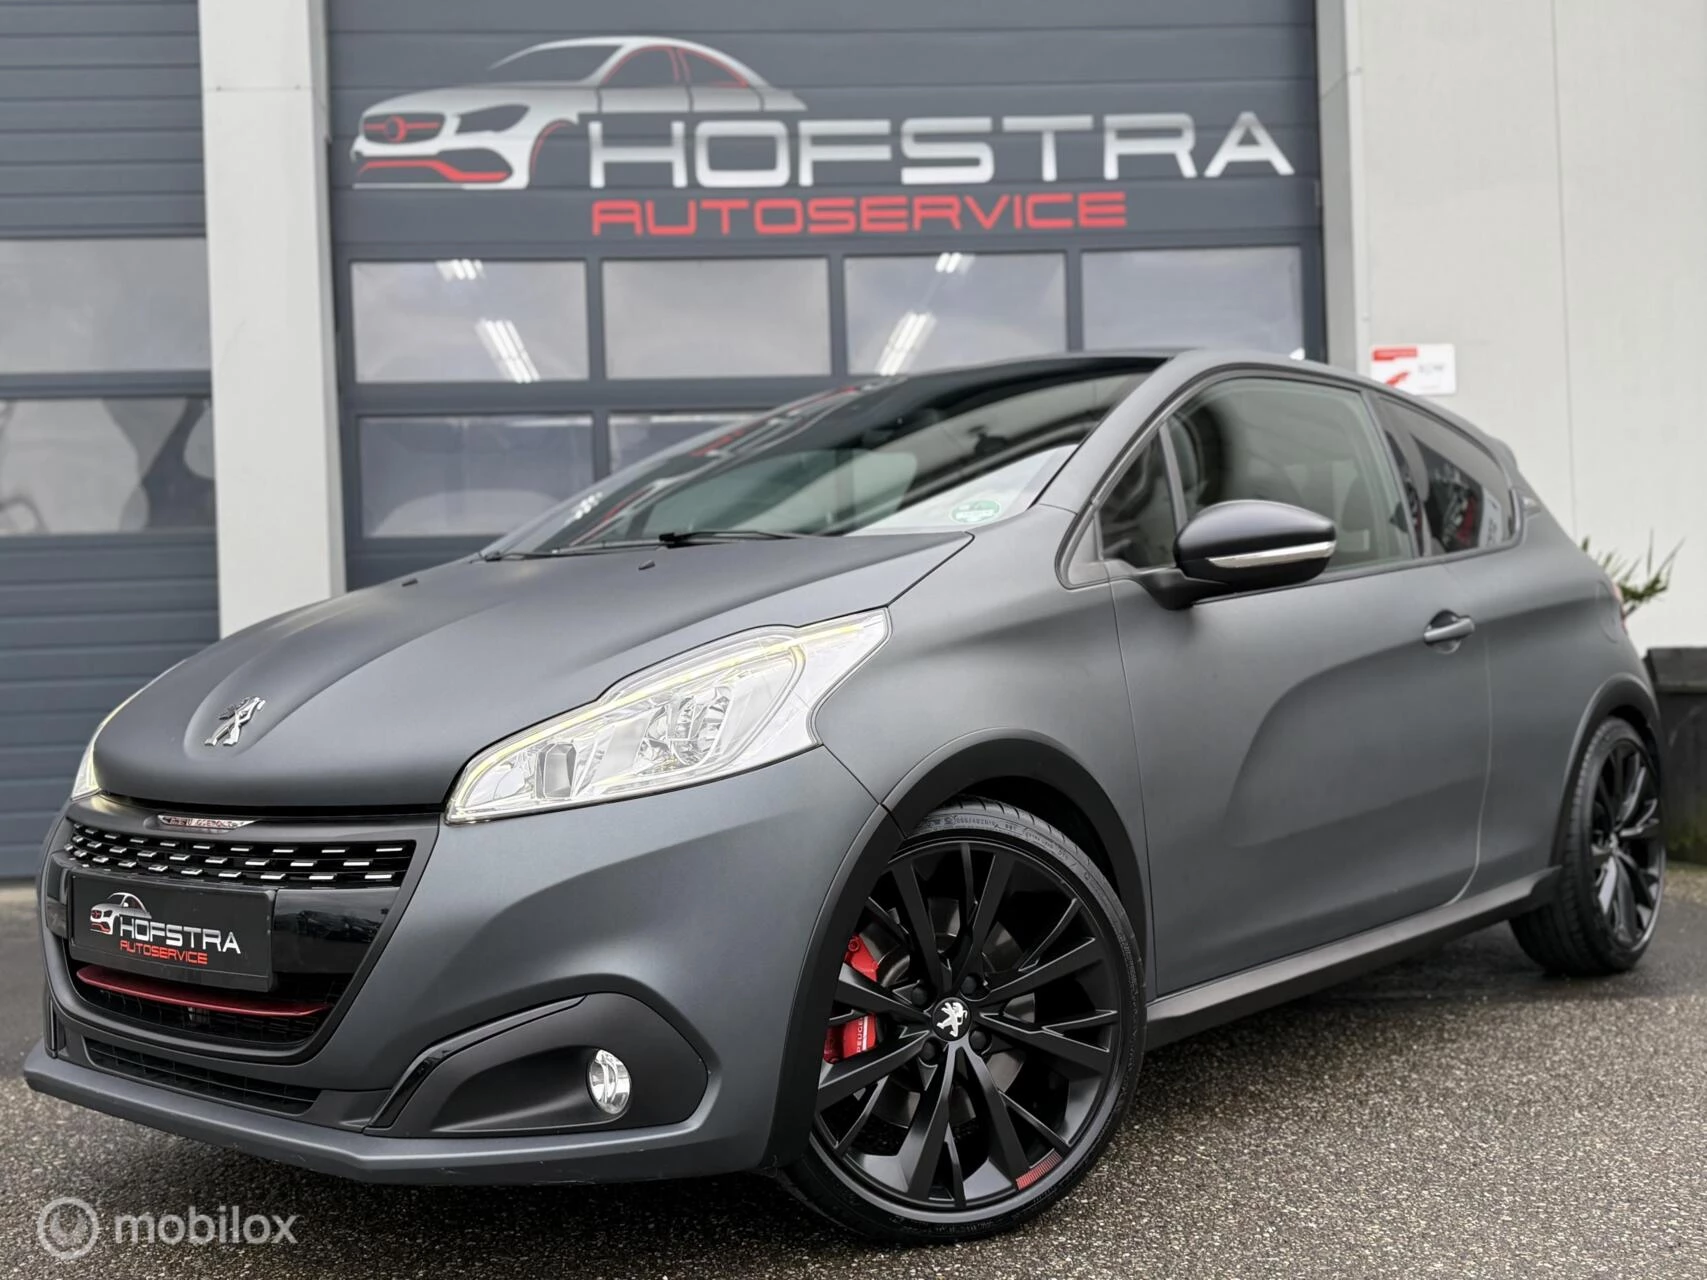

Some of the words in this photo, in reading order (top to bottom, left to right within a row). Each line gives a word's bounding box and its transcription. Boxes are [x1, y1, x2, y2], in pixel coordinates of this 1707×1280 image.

[588, 111, 1295, 188] HOFSTRA
[591, 191, 1127, 237] AUTOSERVICE
[119, 916, 241, 954] HOFSTRA
[119, 940, 208, 965] AUTOSERVICE
